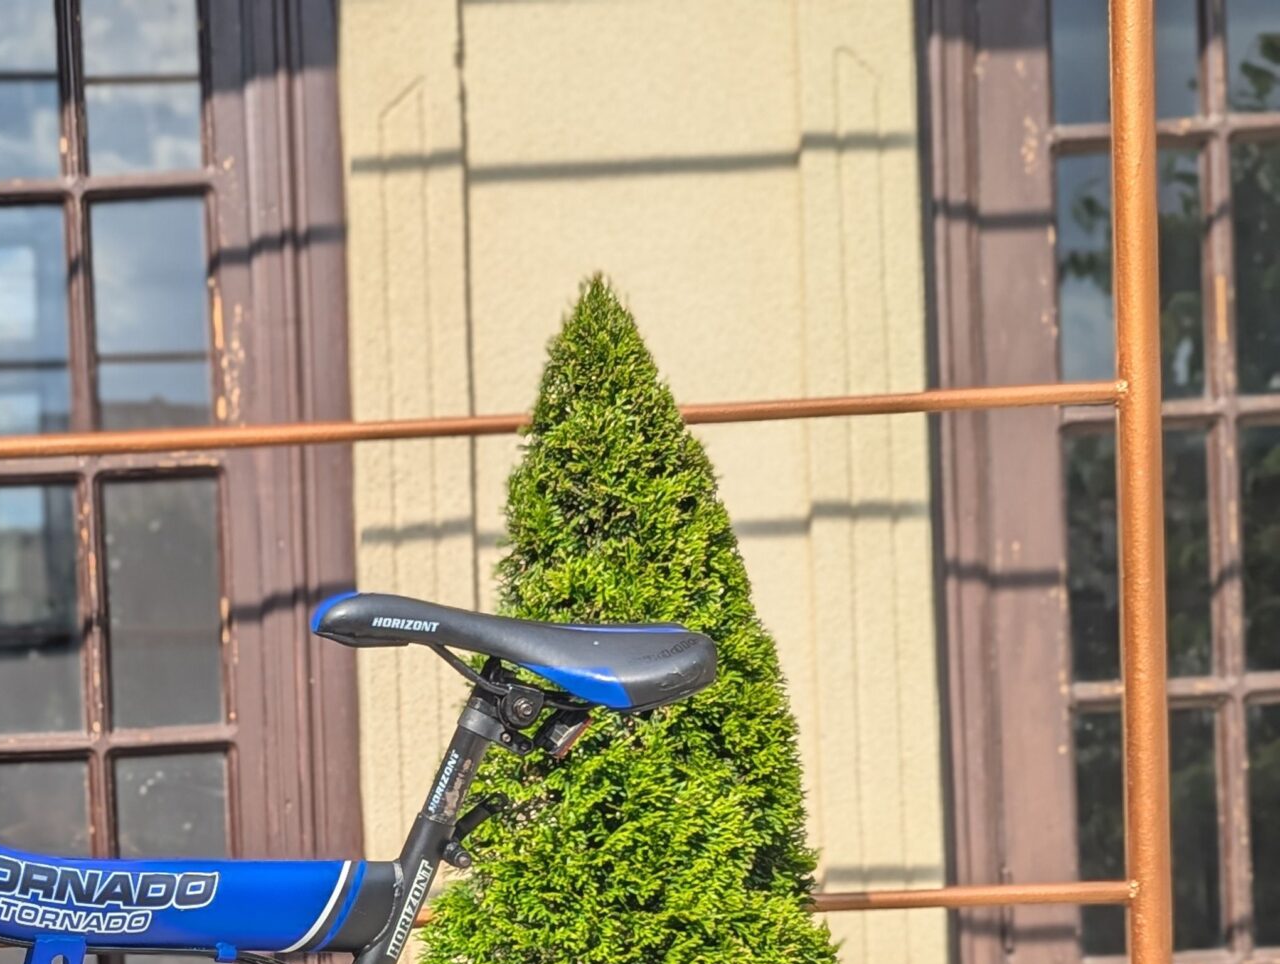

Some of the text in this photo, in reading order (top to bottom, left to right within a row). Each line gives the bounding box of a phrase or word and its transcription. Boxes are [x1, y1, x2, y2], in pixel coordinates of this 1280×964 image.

[372, 617, 440, 632] HORIZONT
[428, 749, 459, 814] HORIZONT
[386, 859, 433, 960] HORIZONT
